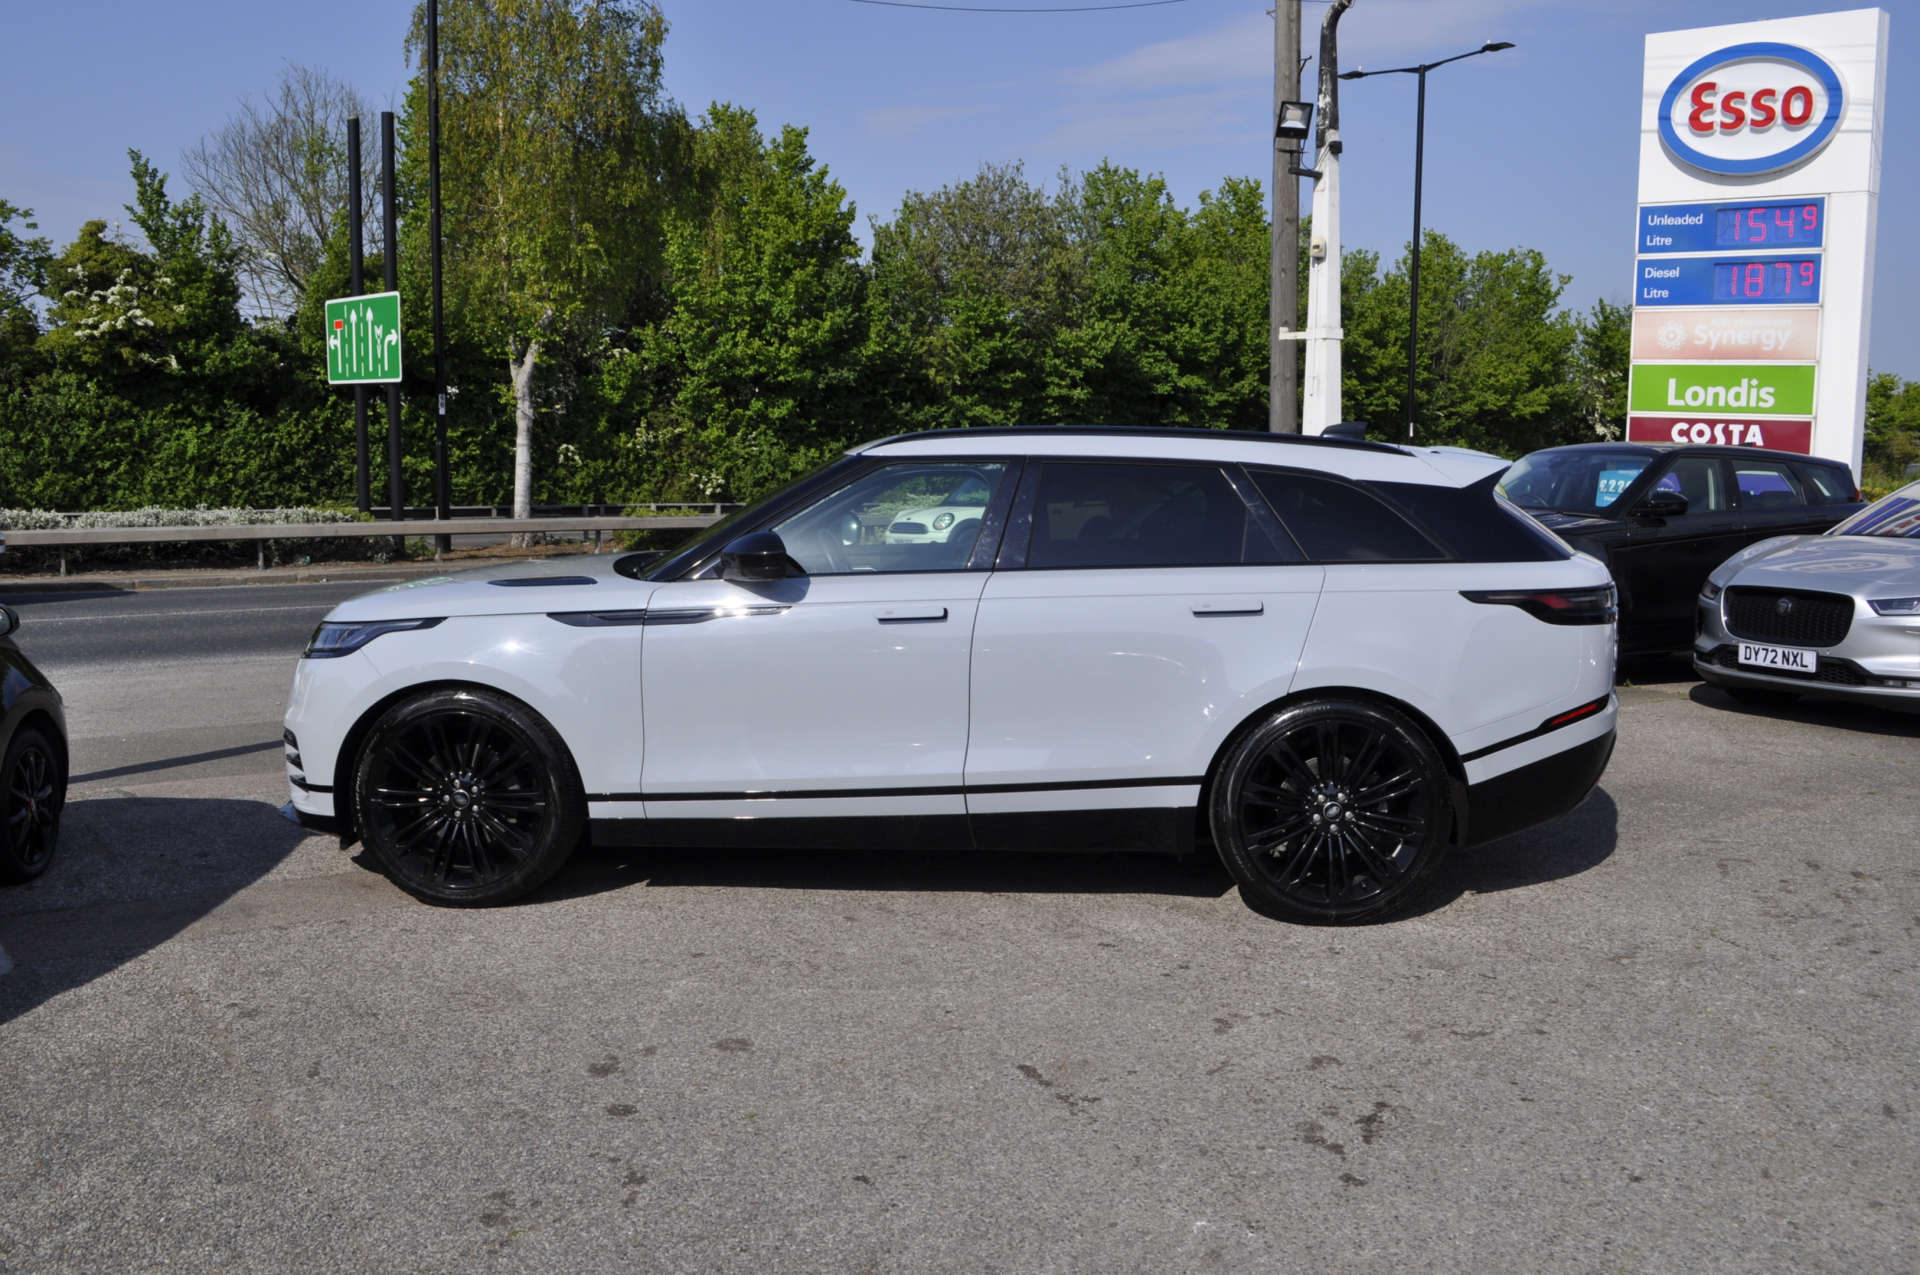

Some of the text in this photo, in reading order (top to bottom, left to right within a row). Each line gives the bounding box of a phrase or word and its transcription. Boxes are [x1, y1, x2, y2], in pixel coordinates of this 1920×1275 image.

[1648, 213, 1703, 227] Unleaded
[1646, 234, 1672, 246] Litre
[1644, 267, 1680, 279] Diesel
[1643, 287, 1669, 299] Litre
[1694, 323, 1793, 351] Synergy
[1667, 378, 1775, 408] Londis
[1671, 422, 1764, 446] COSTA
[1744, 645, 1809, 668] DY72 NXL
